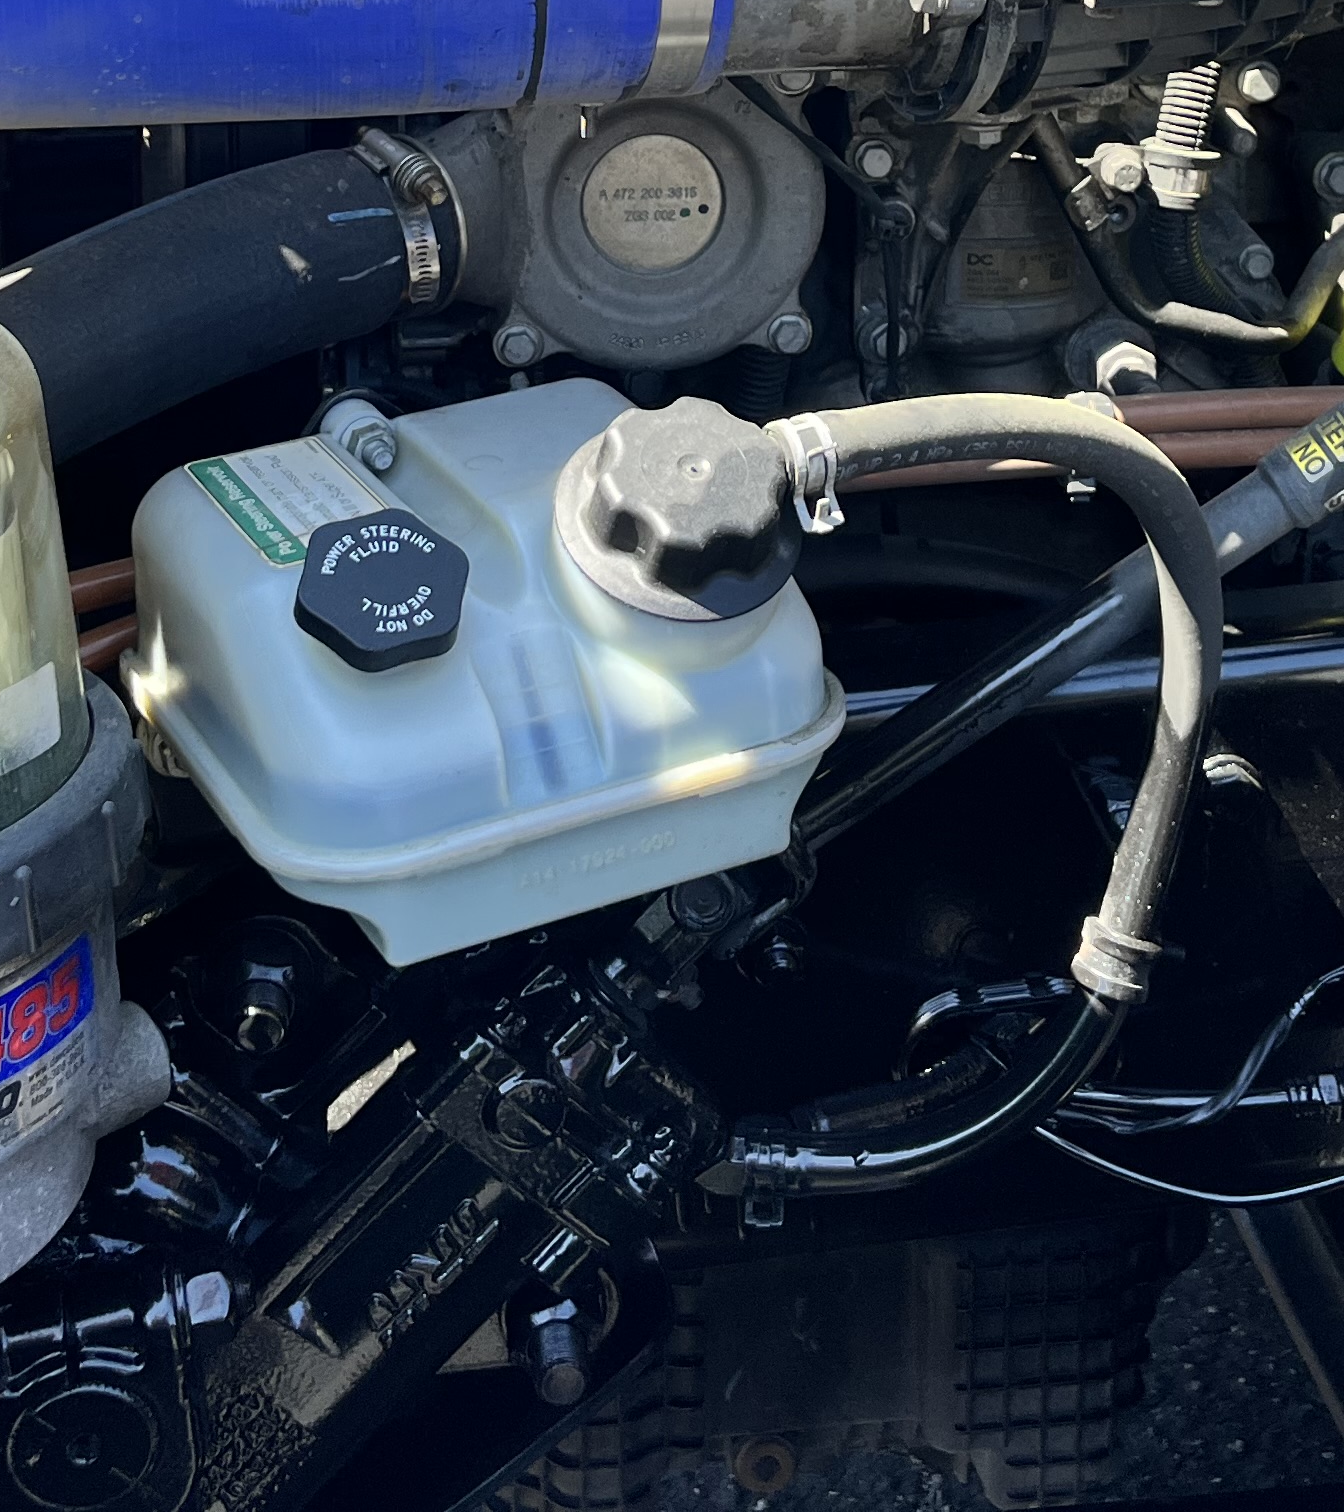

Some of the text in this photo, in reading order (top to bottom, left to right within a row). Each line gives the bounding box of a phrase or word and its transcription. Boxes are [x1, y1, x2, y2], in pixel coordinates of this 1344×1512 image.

[599, 189, 608, 201] A
[613, 188, 635, 200] 472
[967, 253, 993, 266] DC
[1293, 442, 1326, 475] NO
[206, 465, 246, 501] Reservoir
[238, 497, 275, 532] Steering
[321, 524, 437, 576] POWER STEERING
[349, 540, 400, 563] FLUID
[361, 585, 433, 618] OVERFILL
[375, 608, 435, 633] DO NOT
